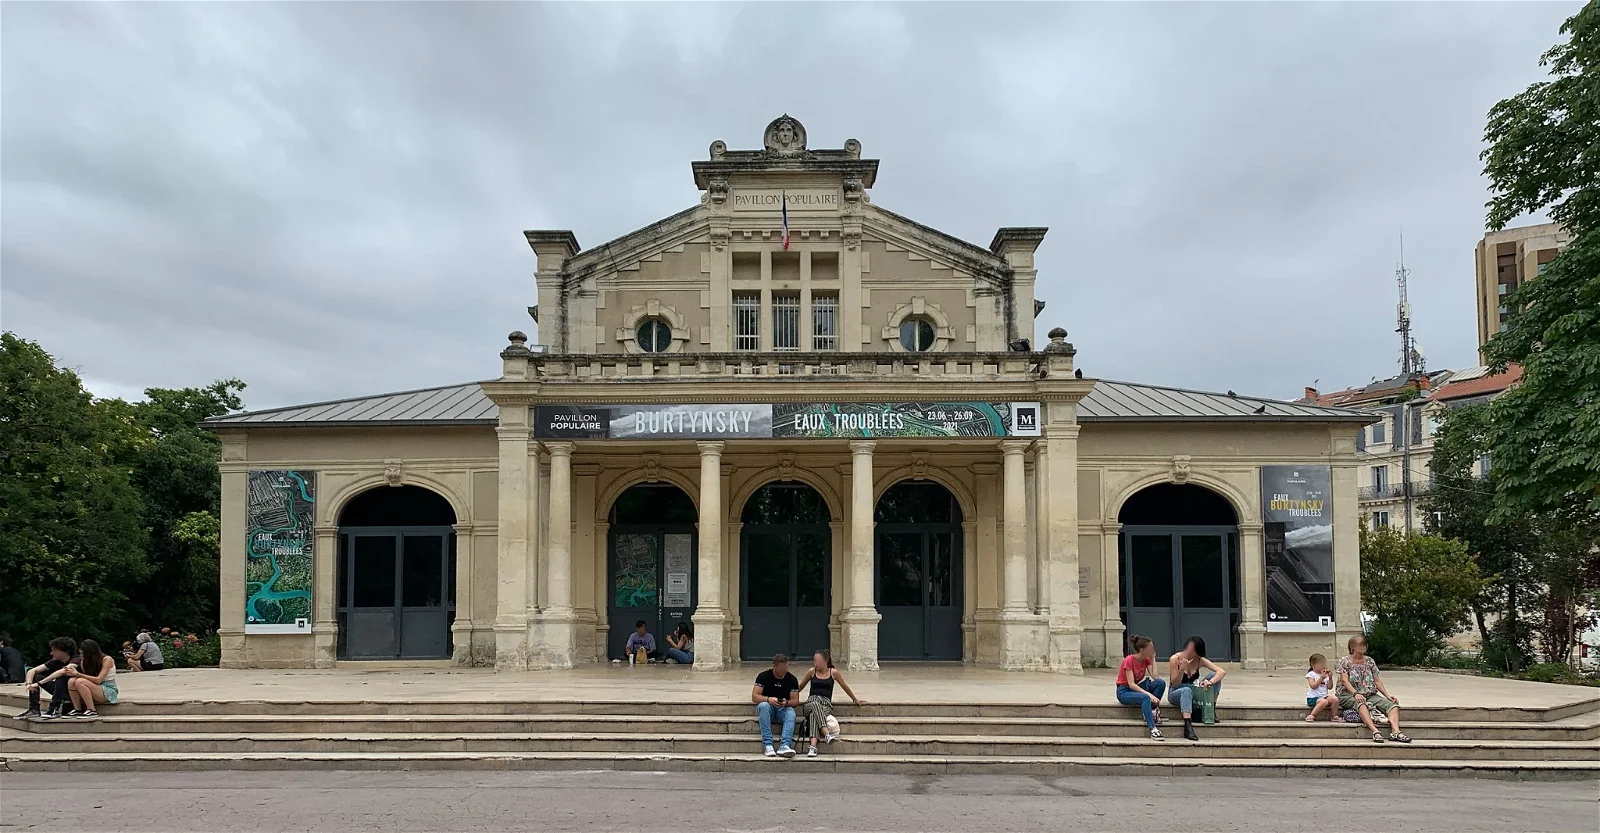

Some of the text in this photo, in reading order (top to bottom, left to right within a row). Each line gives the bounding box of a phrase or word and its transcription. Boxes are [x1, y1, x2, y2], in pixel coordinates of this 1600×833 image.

[735, 194, 837, 205] PAVILLON POPULAIRE
[554, 414, 597, 422] PAVILLON
[794, 410, 904, 430] EAUX TROUBLÉES
[927, 411, 947, 420] 23.06
[954, 411, 973, 420] 26.09
[1020, 414, 1033, 425] M
[550, 422, 601, 430] POPULAIRE
[635, 411, 753, 434] BURTYNSKY
[942, 421, 958, 431] 2021
[1273, 493, 1289, 501] EAUX
[1270, 499, 1324, 511] BURTYNSKY
[258, 533, 273, 541] EAUX
